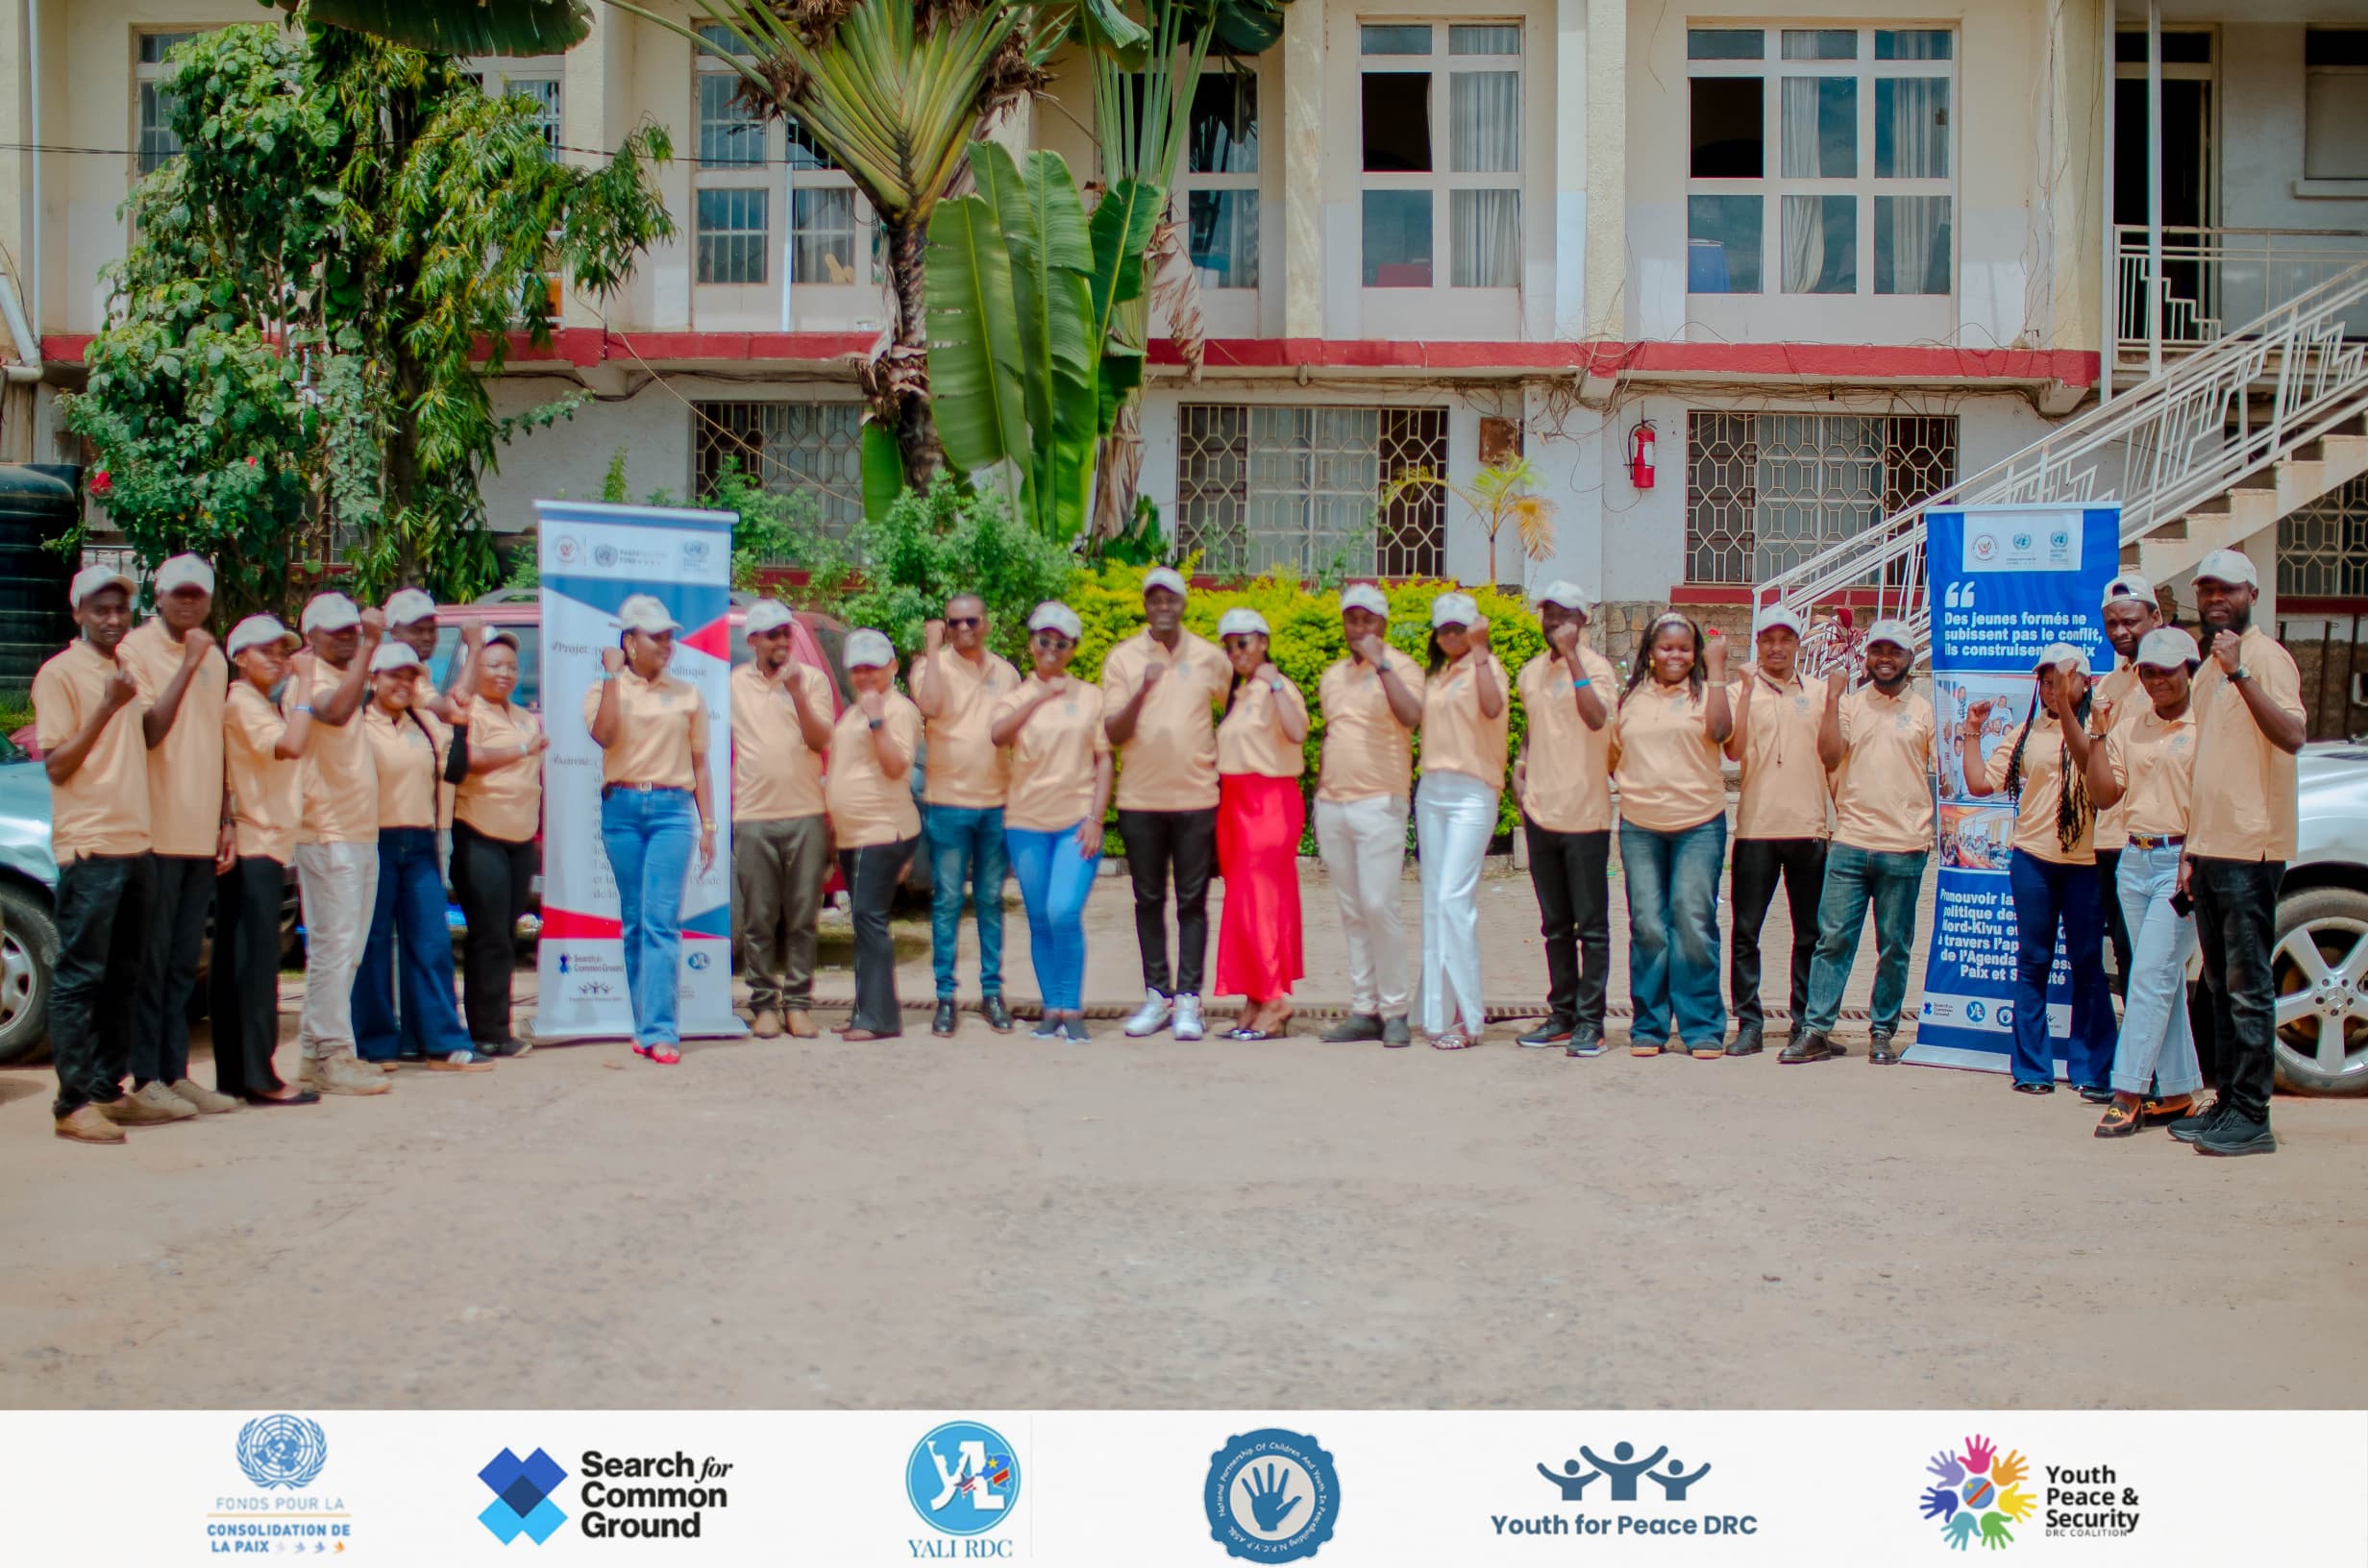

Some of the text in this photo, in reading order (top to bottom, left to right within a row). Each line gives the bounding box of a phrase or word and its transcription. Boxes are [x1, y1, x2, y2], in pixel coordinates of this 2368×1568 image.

[1945, 611, 2086, 627] Des jeunes formés ne
[1945, 627, 2103, 644] subissent pas le conflit,
[1961, 644, 2048, 656] construisen
[2001, 893, 2014, 905] la
[1943, 905, 1993, 920] politique
[1942, 919, 2002, 936] Nord-Kivu
[1944, 934, 1990, 948] travers
[1940, 948, 2017, 967] de l'Agenda
[1961, 964, 1988, 979] Paix
[1991, 968, 2006, 981] et
